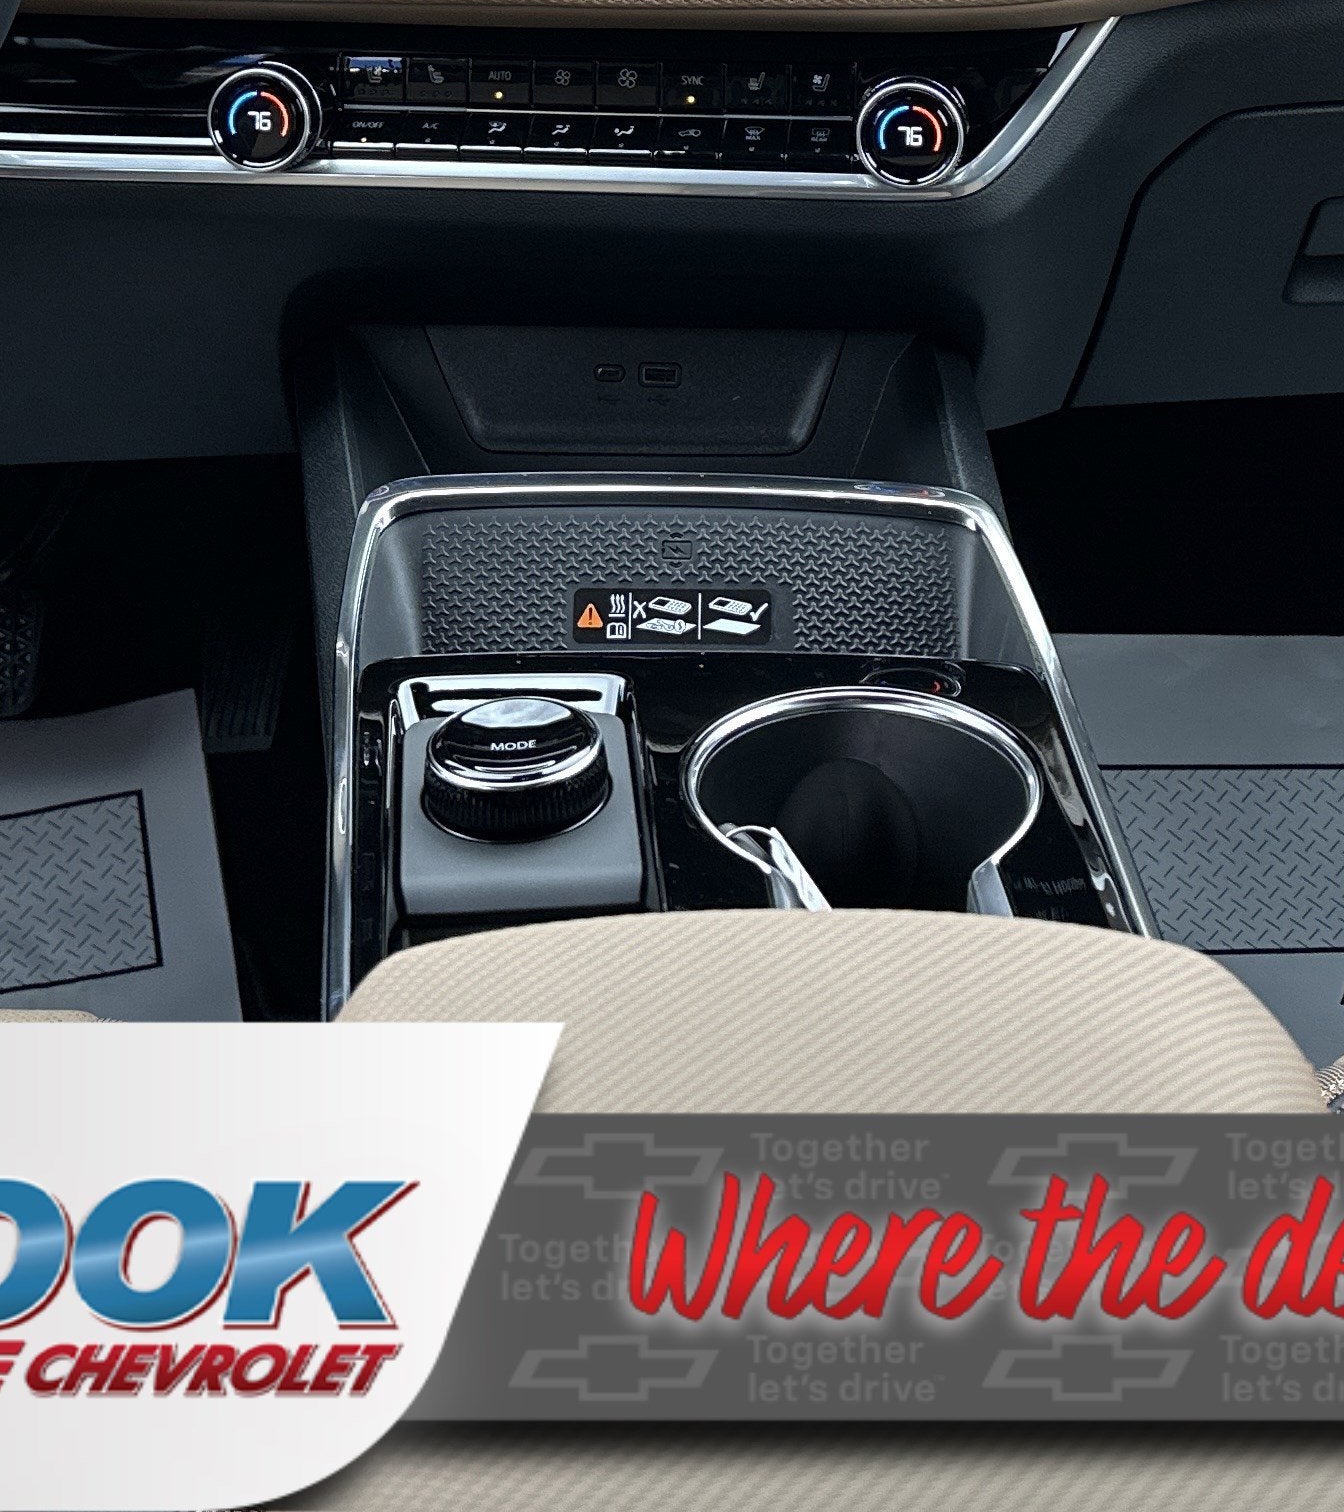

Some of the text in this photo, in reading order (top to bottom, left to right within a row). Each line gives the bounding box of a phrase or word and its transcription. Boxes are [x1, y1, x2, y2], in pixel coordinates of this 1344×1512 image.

[488, 71, 512, 81] AUTO
[681, 75, 705, 87] SYNC
[247, 111, 271, 131] 76
[352, 121, 385, 130] ON/OFF
[421, 122, 440, 130] A/C
[897, 126, 923, 147] 76
[490, 739, 537, 752] MODE
